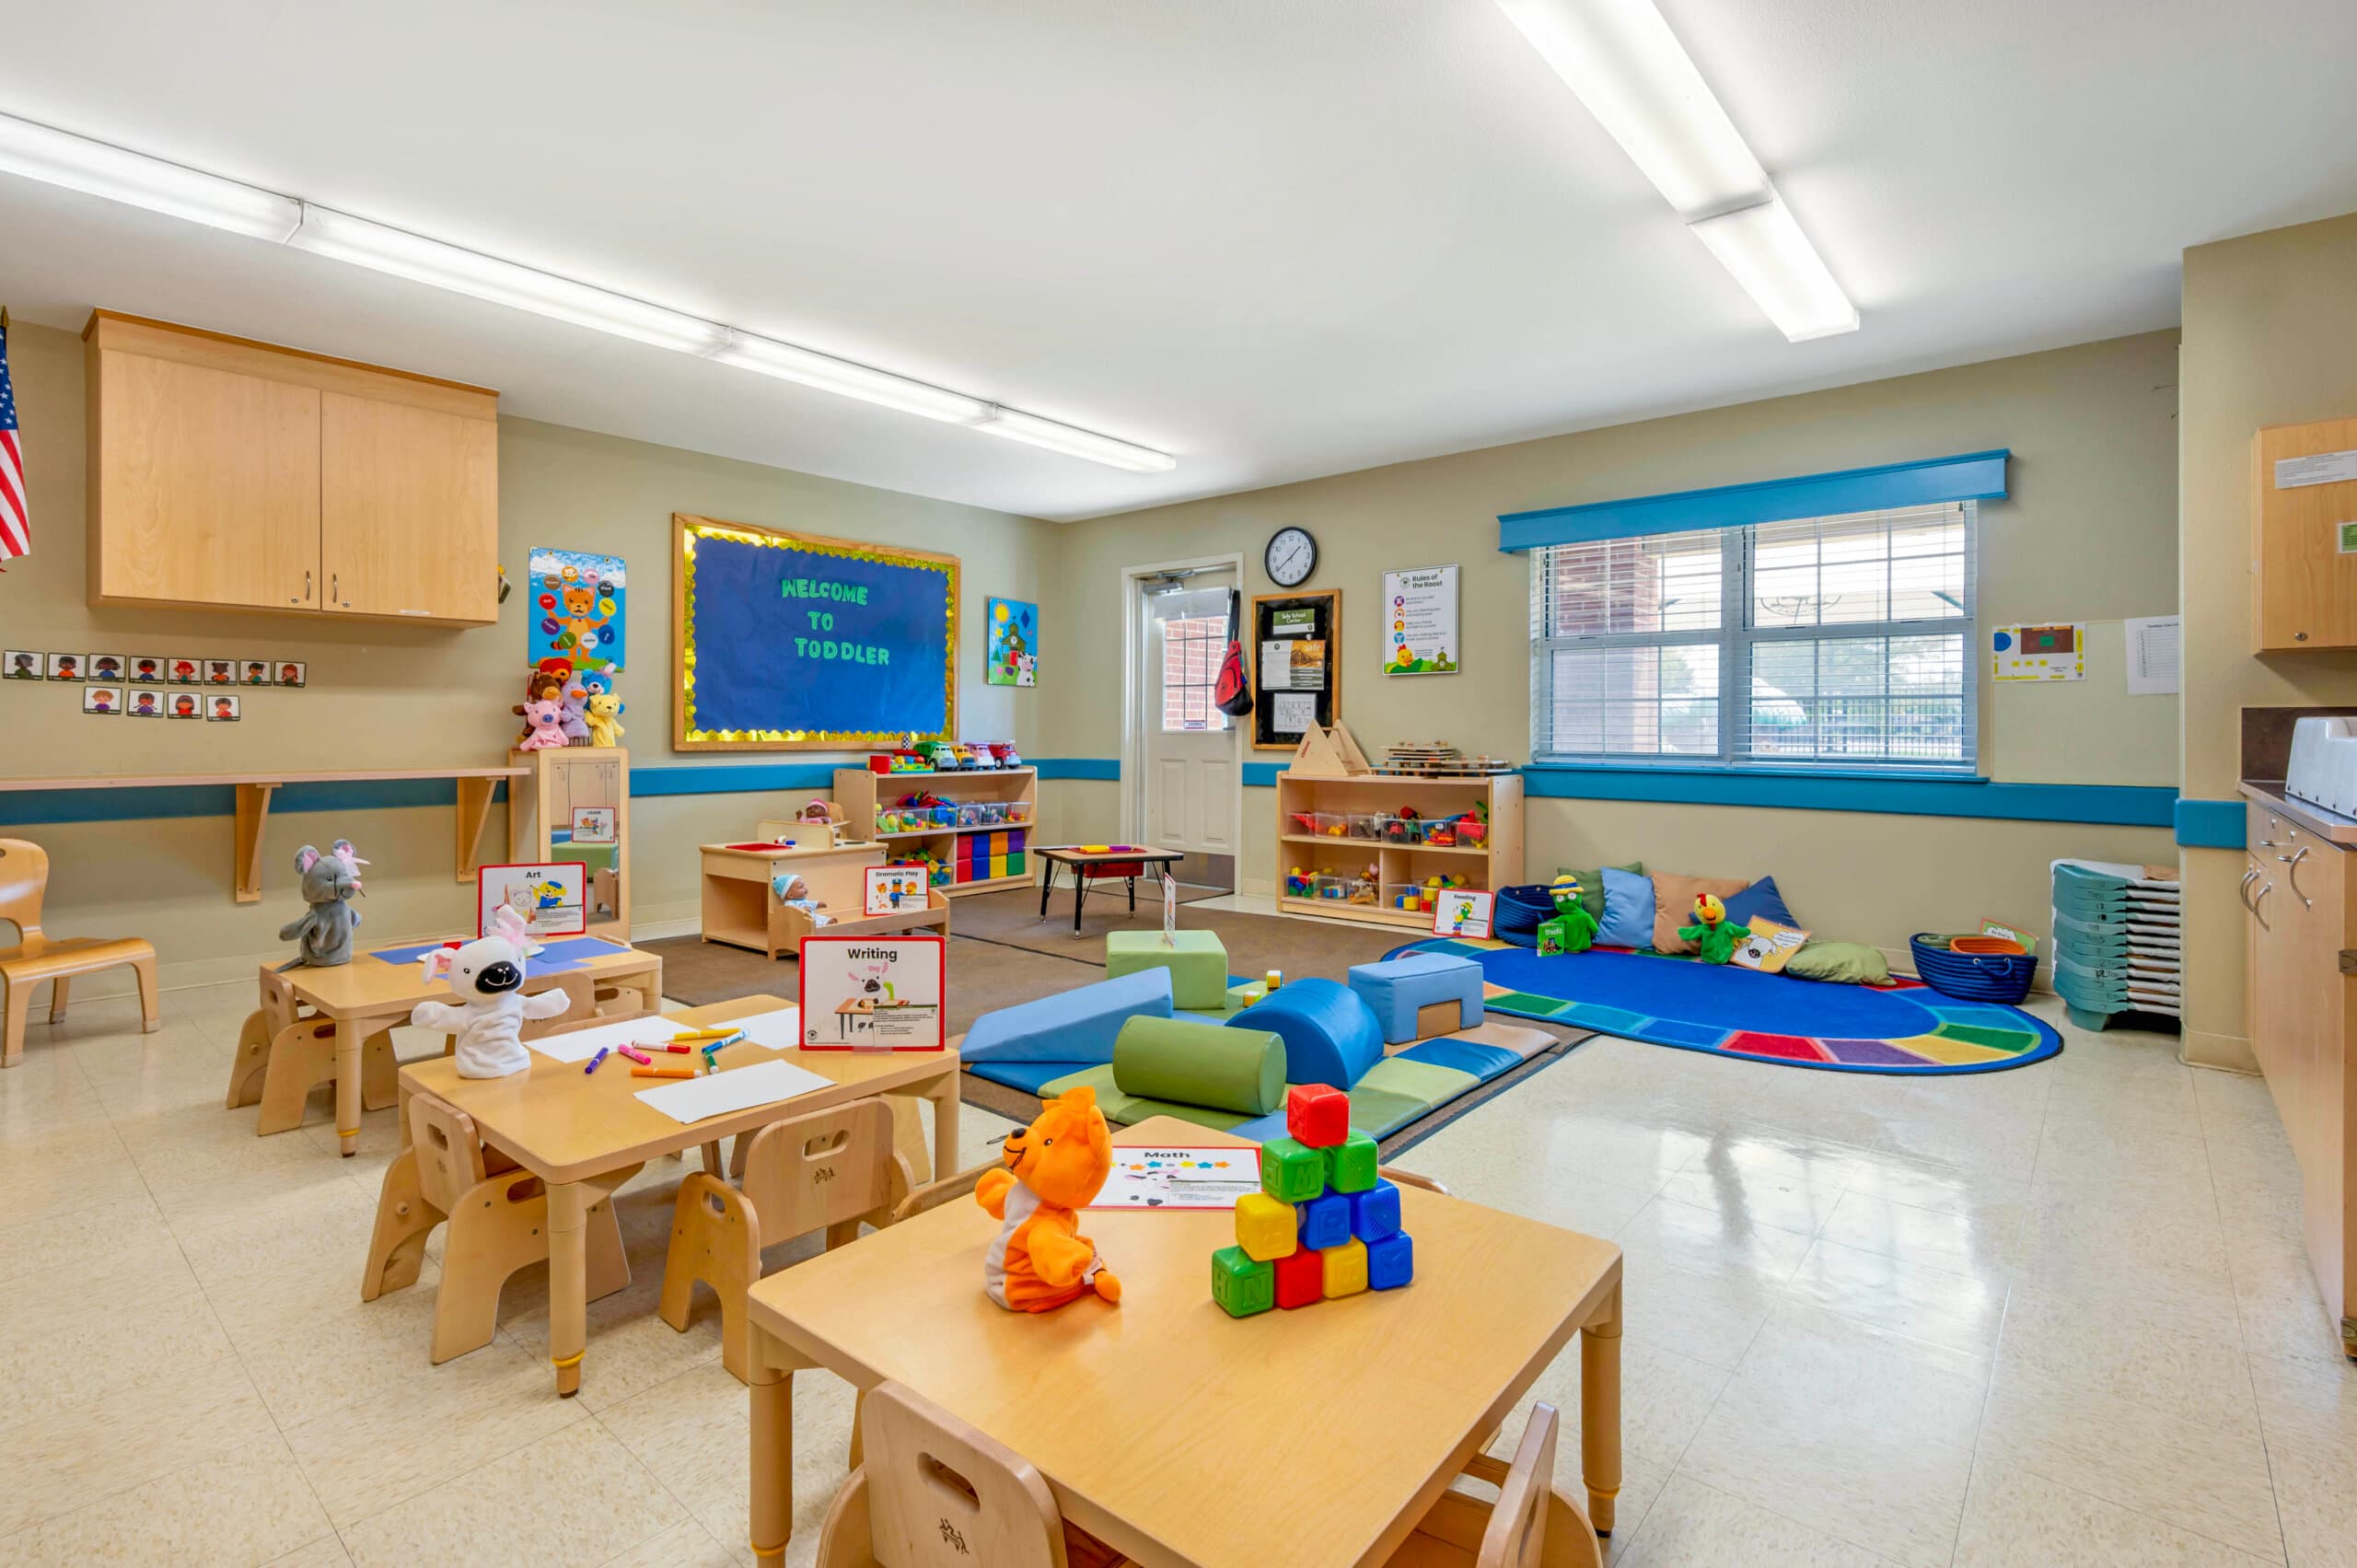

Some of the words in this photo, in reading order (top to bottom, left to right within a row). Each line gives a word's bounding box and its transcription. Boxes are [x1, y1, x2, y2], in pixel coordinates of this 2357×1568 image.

[781, 578, 869, 606] WELCOME
[807, 610, 834, 632] TO
[794, 637, 890, 666] TODDLER
[847, 947, 898, 962] Writing
